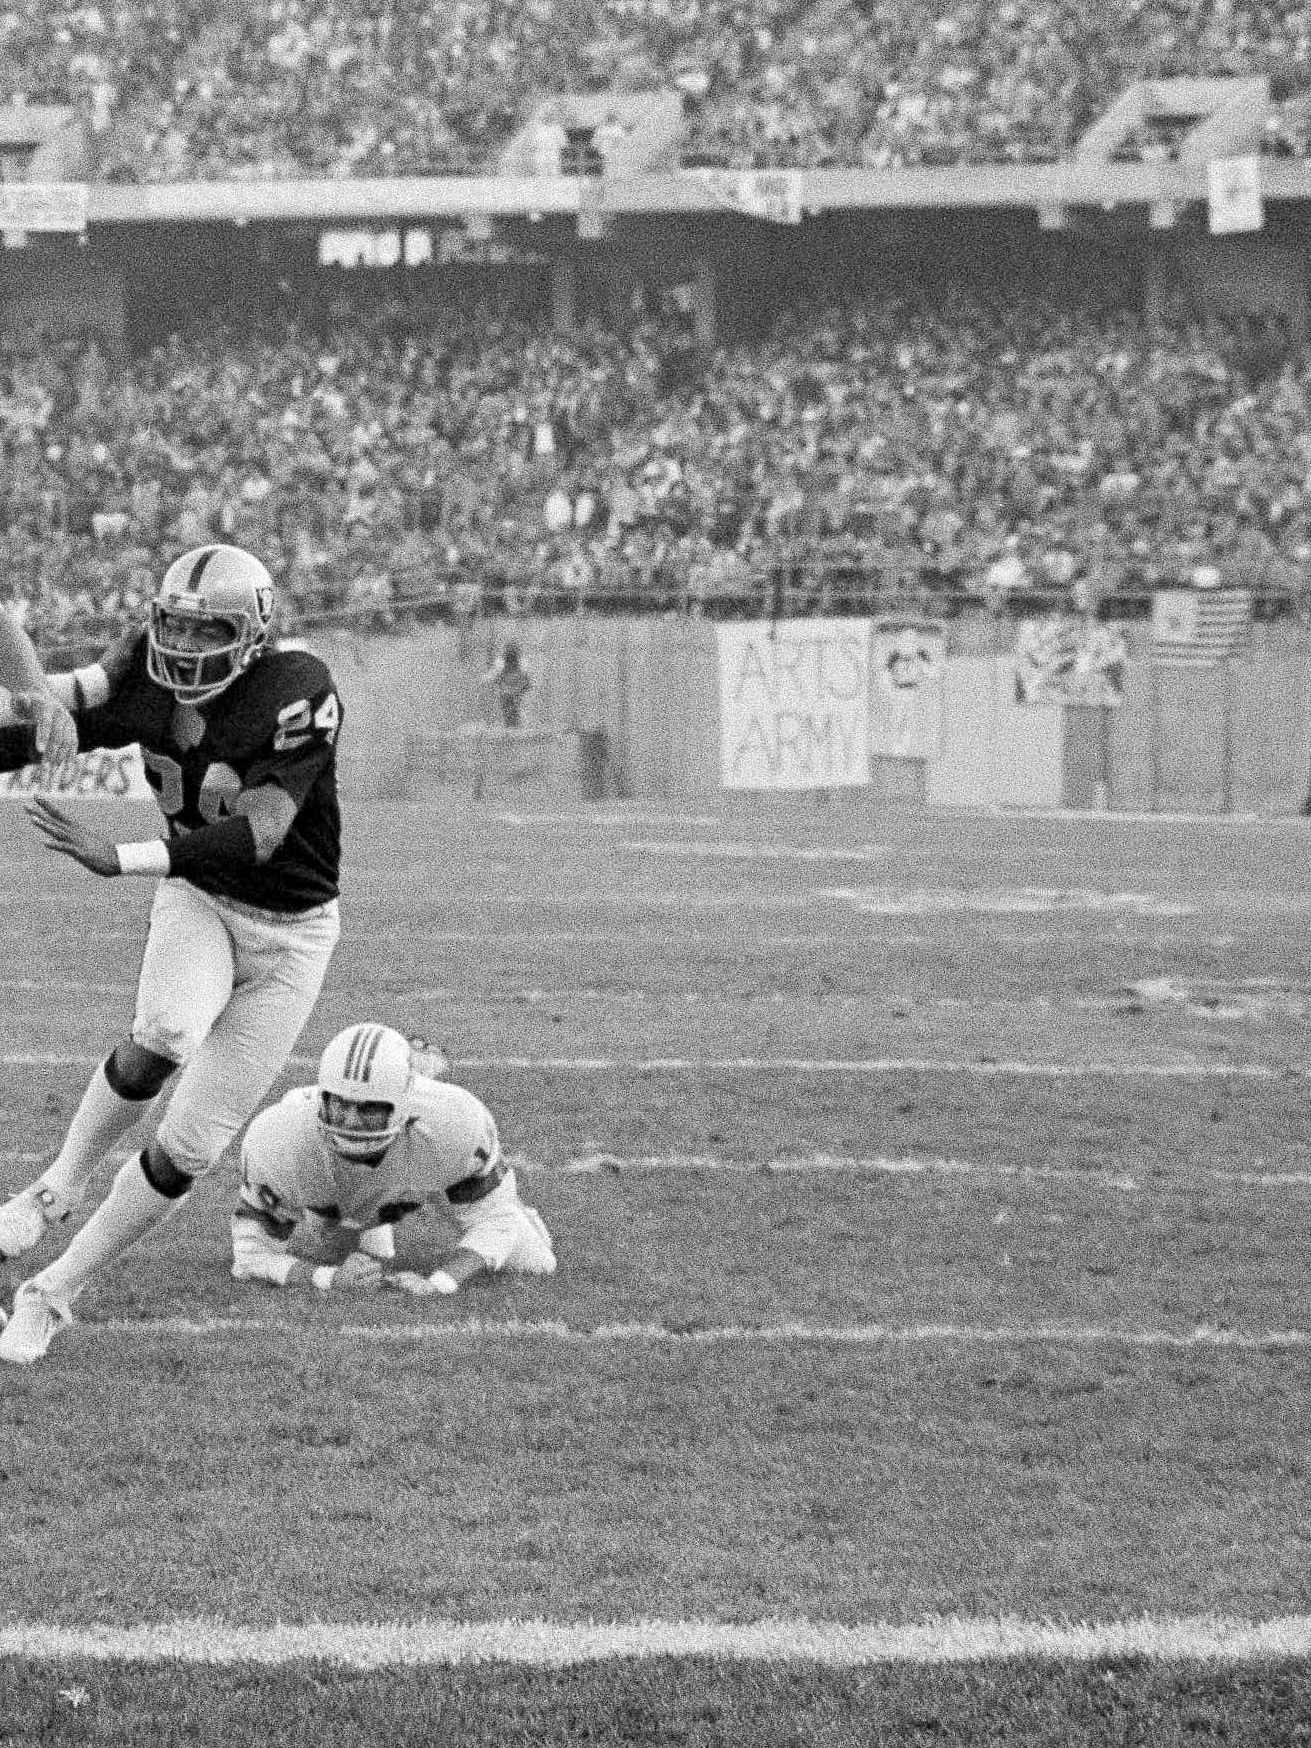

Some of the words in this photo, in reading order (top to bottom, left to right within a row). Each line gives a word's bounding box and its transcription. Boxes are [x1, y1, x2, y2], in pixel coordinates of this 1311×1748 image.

[734, 635, 864, 701] ARTS
[273, 692, 342, 752] 24
[732, 711, 860, 774] ARMY
